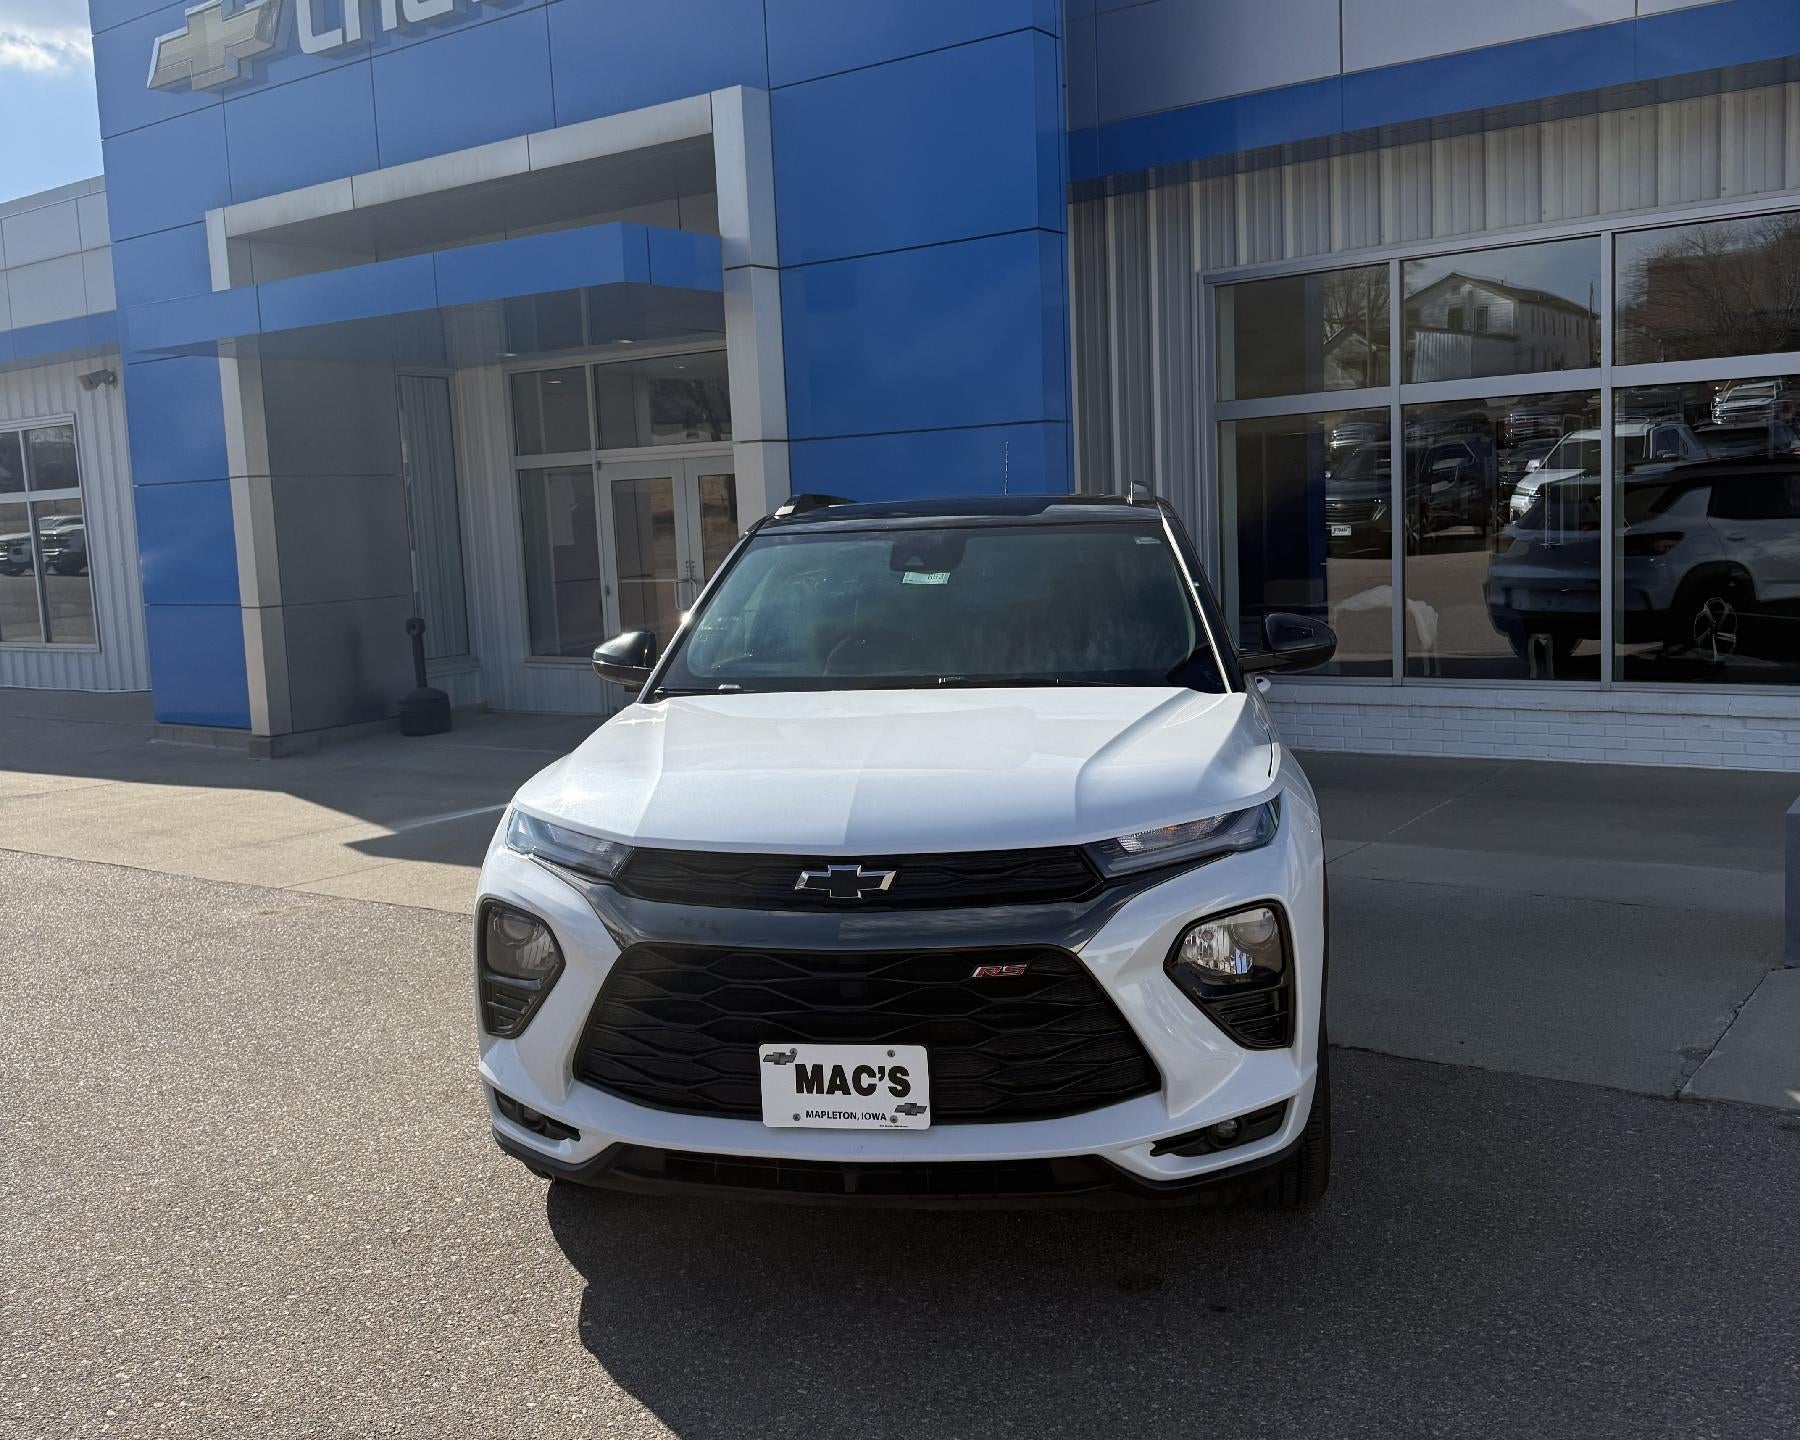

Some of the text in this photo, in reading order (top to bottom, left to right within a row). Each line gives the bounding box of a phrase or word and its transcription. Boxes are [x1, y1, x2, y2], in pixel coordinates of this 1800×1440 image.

[971, 964, 1028, 978] RS
[795, 1063, 912, 1098] MAC'S
[805, 1110, 887, 1122] MAPLETON, IOWA
